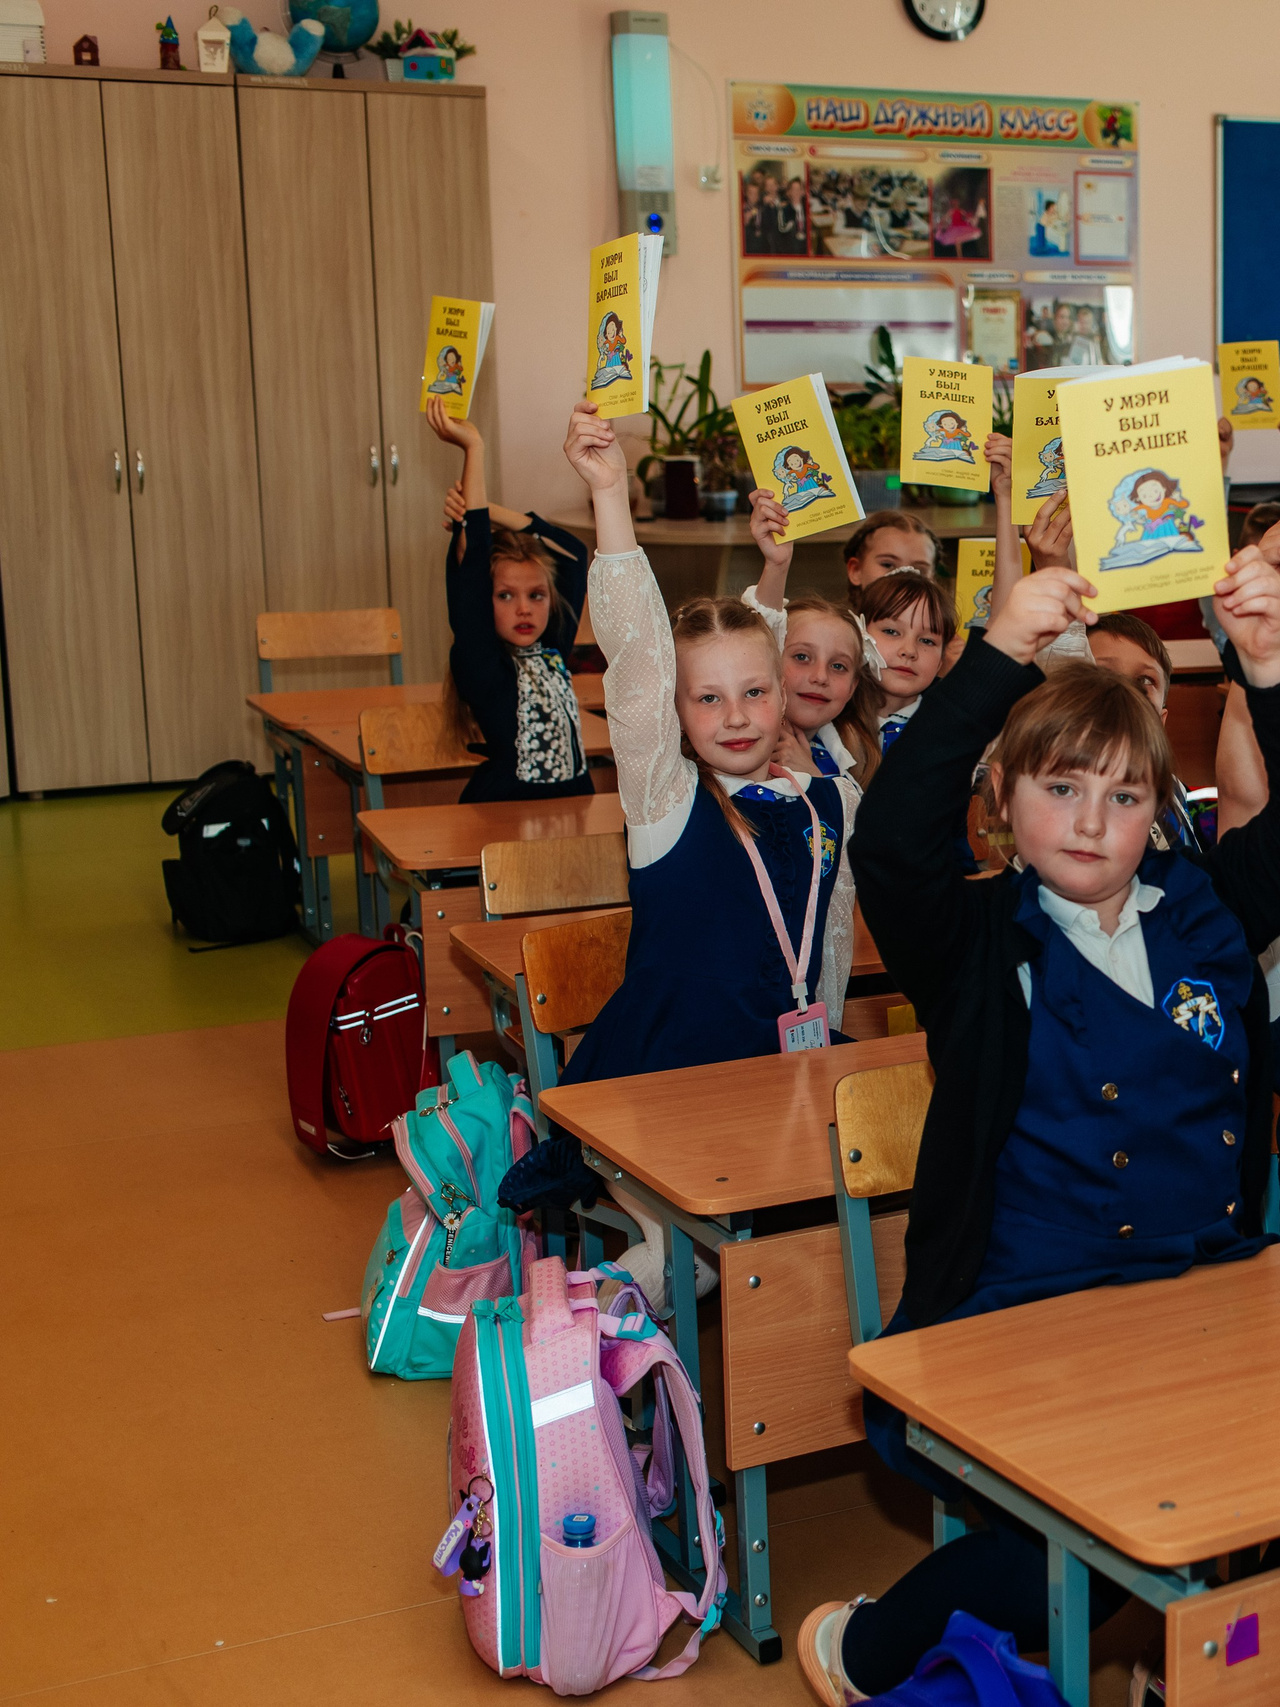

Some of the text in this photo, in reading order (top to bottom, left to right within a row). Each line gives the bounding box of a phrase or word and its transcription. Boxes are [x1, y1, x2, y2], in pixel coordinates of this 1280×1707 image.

[806, 97, 1076, 138] НАШ ДРУЖНЫЙ КЛАСС
[601, 252, 623, 269] У МЭРИ
[603, 269, 618, 284] БЫЛ
[596, 283, 628, 303] БАРАШЕК
[929, 368, 967, 380] У МЭРИ
[935, 380, 960, 391] БЫЛ
[1047, 389, 1056, 399] У
[755, 394, 792, 414] У МЭРИ
[919, 389, 975, 404] БАРАШЕК
[1104, 389, 1170, 412] У МЭРИ
[765, 410, 790, 426] БЫЛ
[1119, 413, 1160, 432] БЫЛ
[756, 418, 809, 444] БАРАШЕК
[1094, 430, 1189, 458] БАРАШЕК
[434, 1523, 461, 1566] Kuromi
